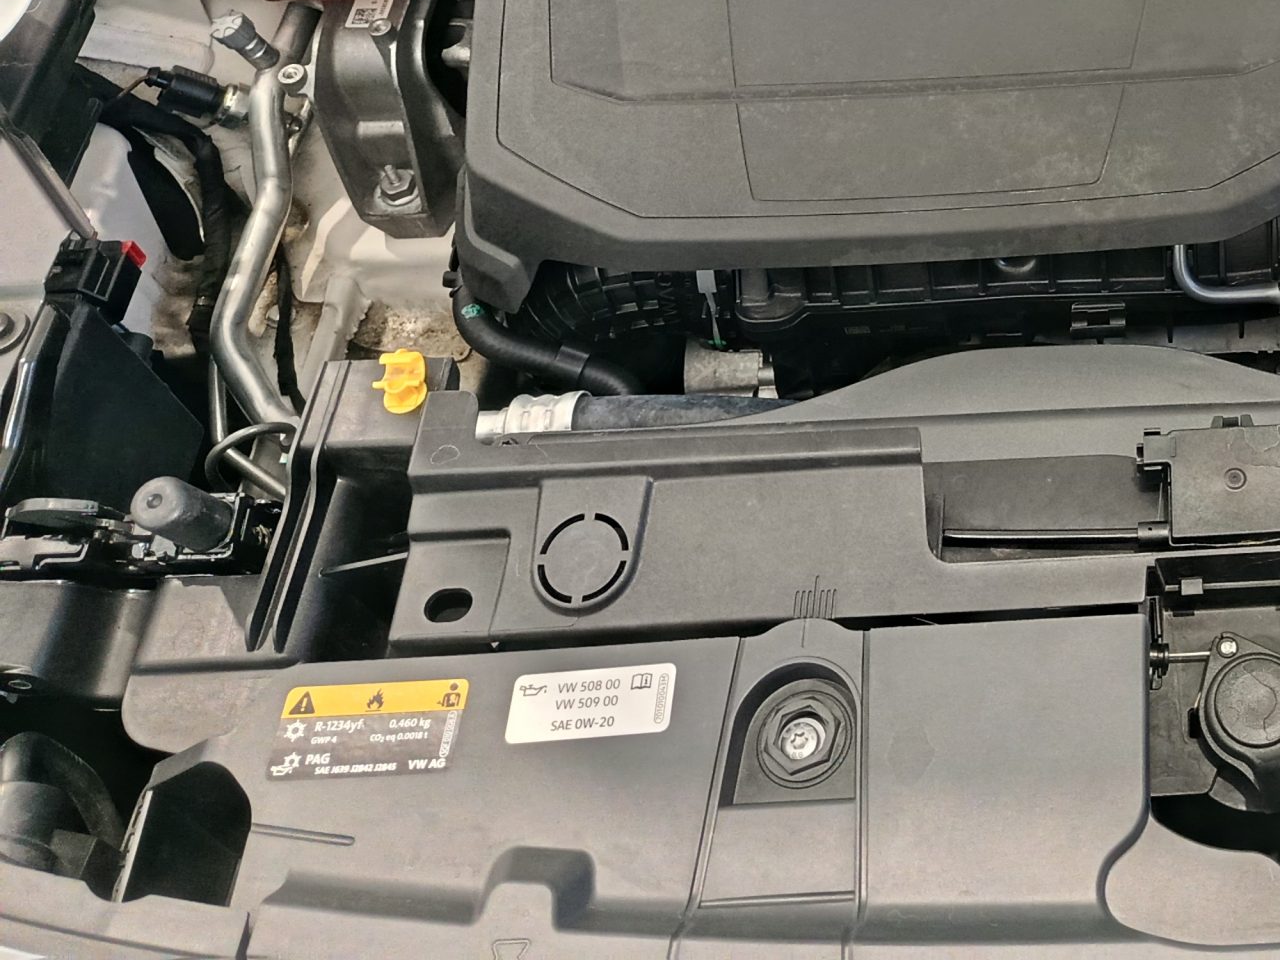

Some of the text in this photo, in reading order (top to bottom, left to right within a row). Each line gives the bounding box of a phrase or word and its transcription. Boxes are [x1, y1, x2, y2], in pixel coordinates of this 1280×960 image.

[558, 678, 621, 694] VW 508 00
[555, 695, 619, 710] VW 509 00
[314, 717, 431, 733] R-1234yf 0.460 kg
[550, 716, 615, 731] SAE 0W-20
[310, 736, 331, 744] GWP
[331, 735, 338, 743] 4
[304, 752, 447, 770] PAG VW AG
[314, 765, 330, 774] SAE
